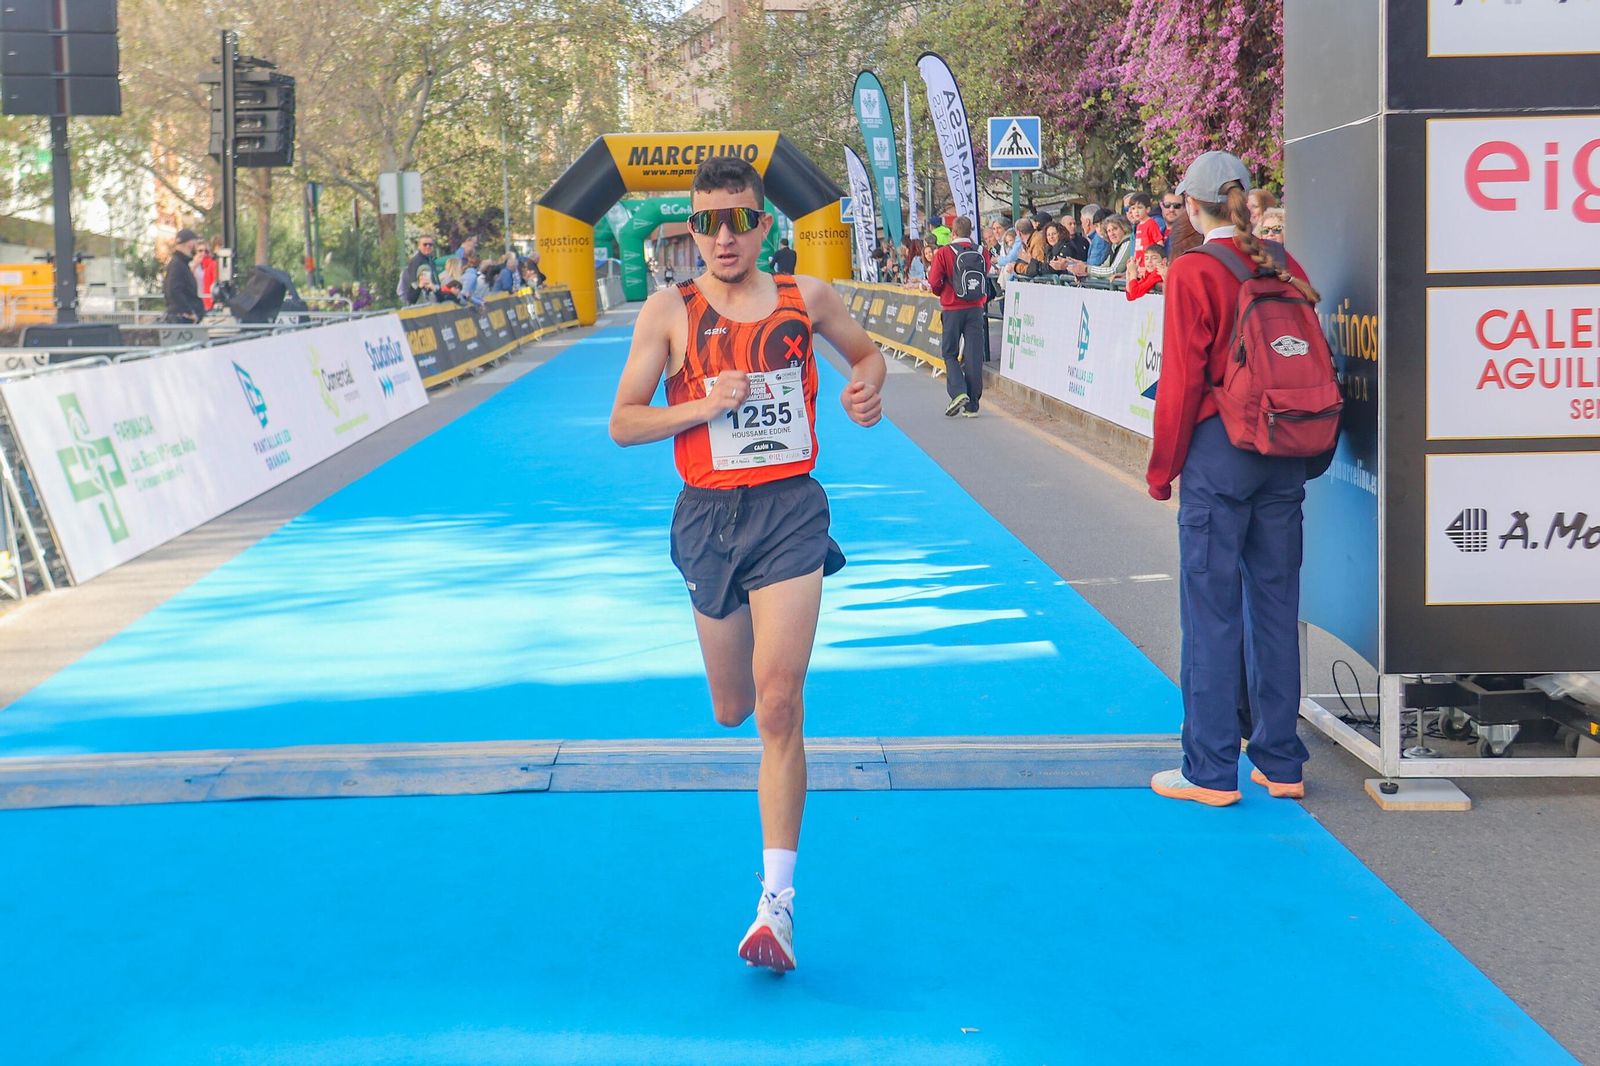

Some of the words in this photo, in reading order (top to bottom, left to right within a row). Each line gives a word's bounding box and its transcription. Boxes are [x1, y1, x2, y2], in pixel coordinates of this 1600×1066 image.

[800, 228, 849, 242] agustinos
[1476, 308, 1600, 351] CALE
[1476, 356, 1600, 390] AGUIL
[726, 402, 792, 430] 1255
[732, 429, 767, 439] HOUSSAME
[769, 426, 792, 435] EDDINE
